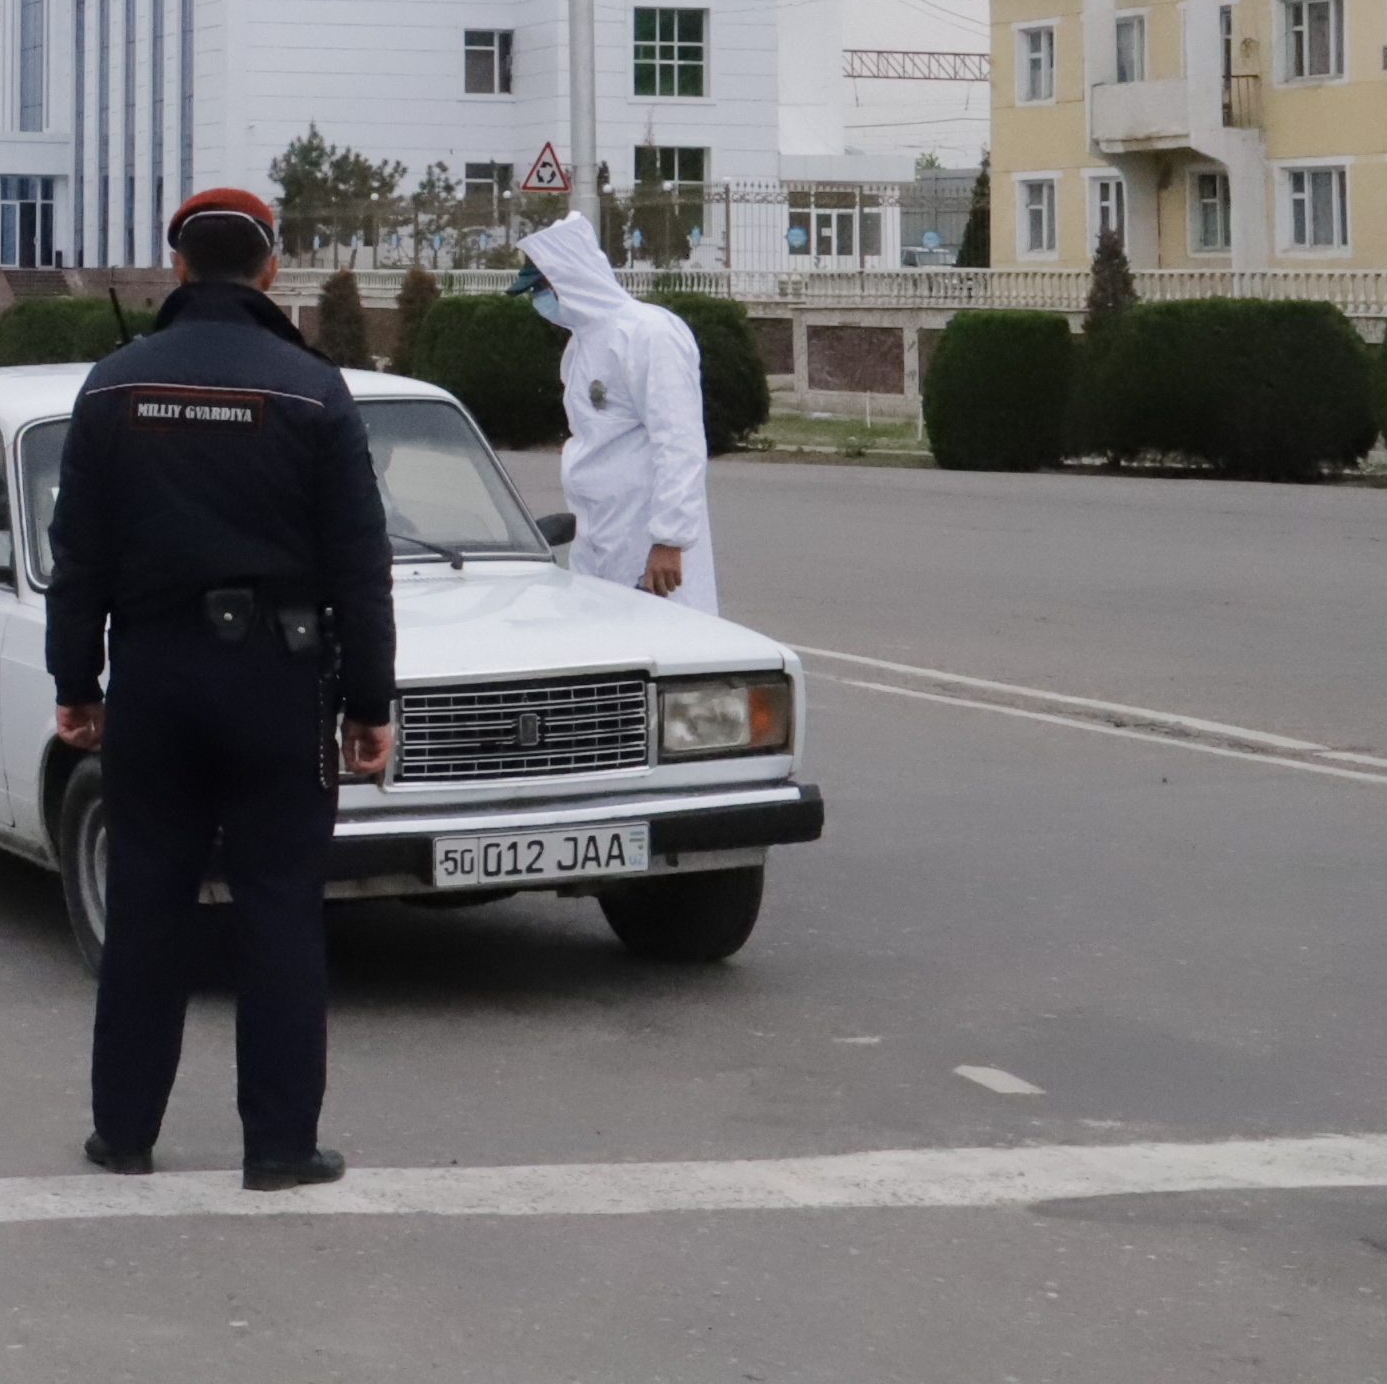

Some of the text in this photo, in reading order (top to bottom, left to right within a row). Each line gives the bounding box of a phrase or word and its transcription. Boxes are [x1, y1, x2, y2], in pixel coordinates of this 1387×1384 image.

[137, 403, 252, 423] MILLIY GVARDIYA
[443, 833, 626, 878] 50 012 JAA
